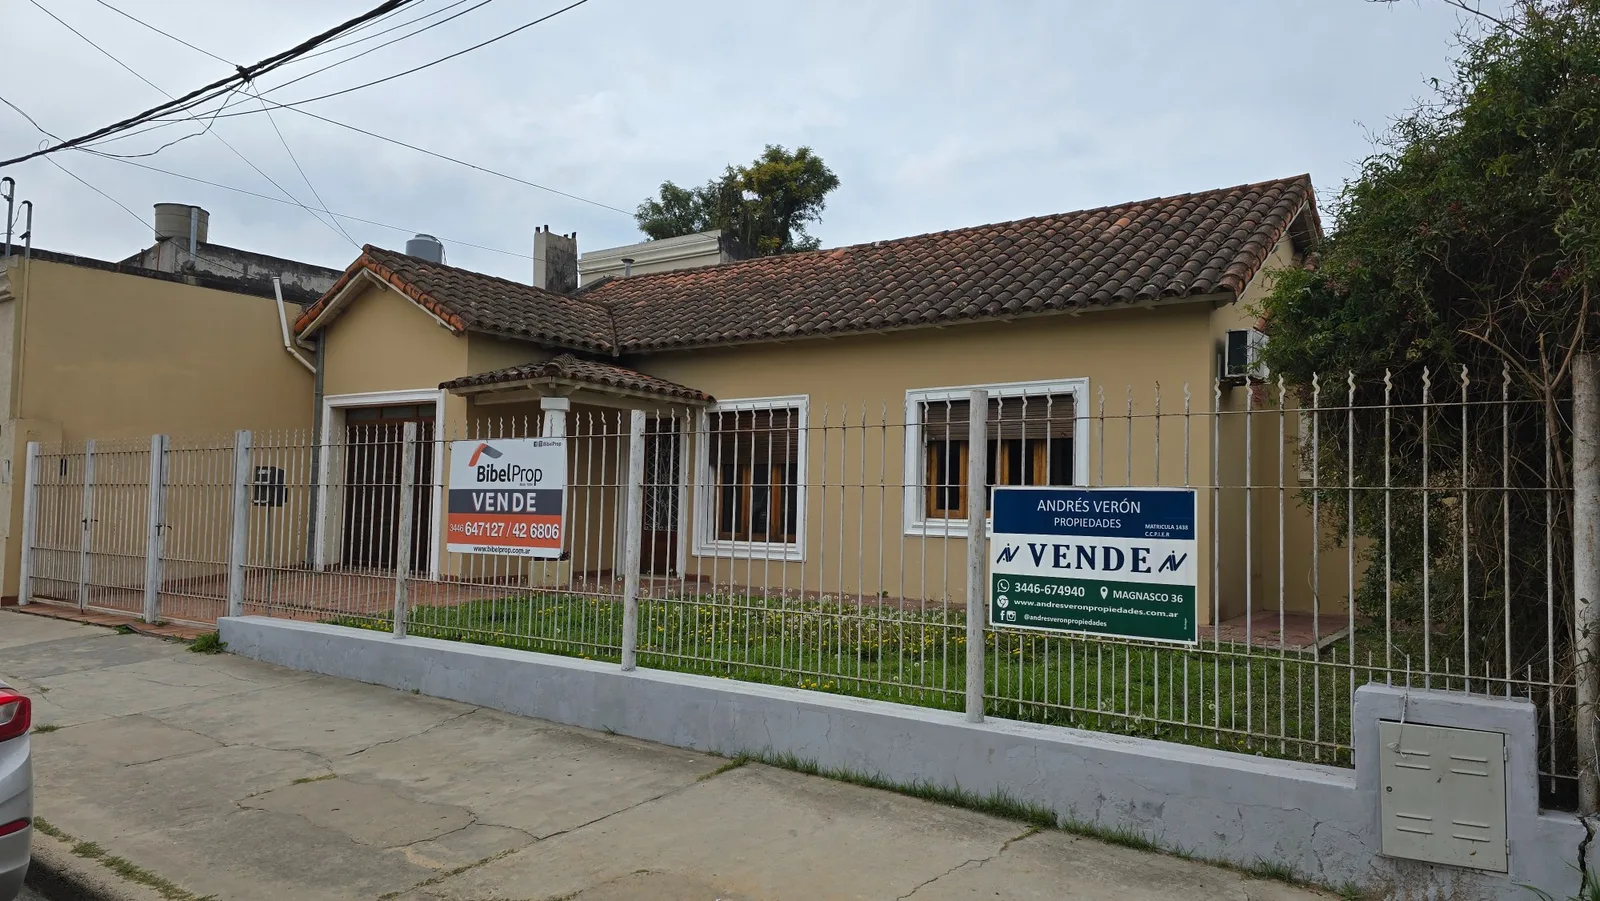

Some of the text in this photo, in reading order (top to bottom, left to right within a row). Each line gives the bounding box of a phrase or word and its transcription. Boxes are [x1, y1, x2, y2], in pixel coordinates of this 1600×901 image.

[477, 463, 542, 486] BibelProp
[472, 492, 536, 512] VENDE
[1037, 498, 1140, 514] ANDRÉS VERÓN
[1054, 517, 1122, 528] PROPIEDADES
[450, 524, 464, 532] 3446
[465, 522, 504, 537] 647127
[512, 522, 526, 538] 42
[530, 523, 560, 540] 6806
[473, 546, 530, 554] www.bibelprop.com.ar
[1027, 543, 1152, 573] VENDE
[1014, 582, 1085, 597] 3446-674940
[1113, 590, 1184, 603] MAGNASCO 36
[1014, 600, 1178, 618] www.andresveronpropiedades.com.ar
[1024, 614, 1107, 627] @andresveronpropiedades
